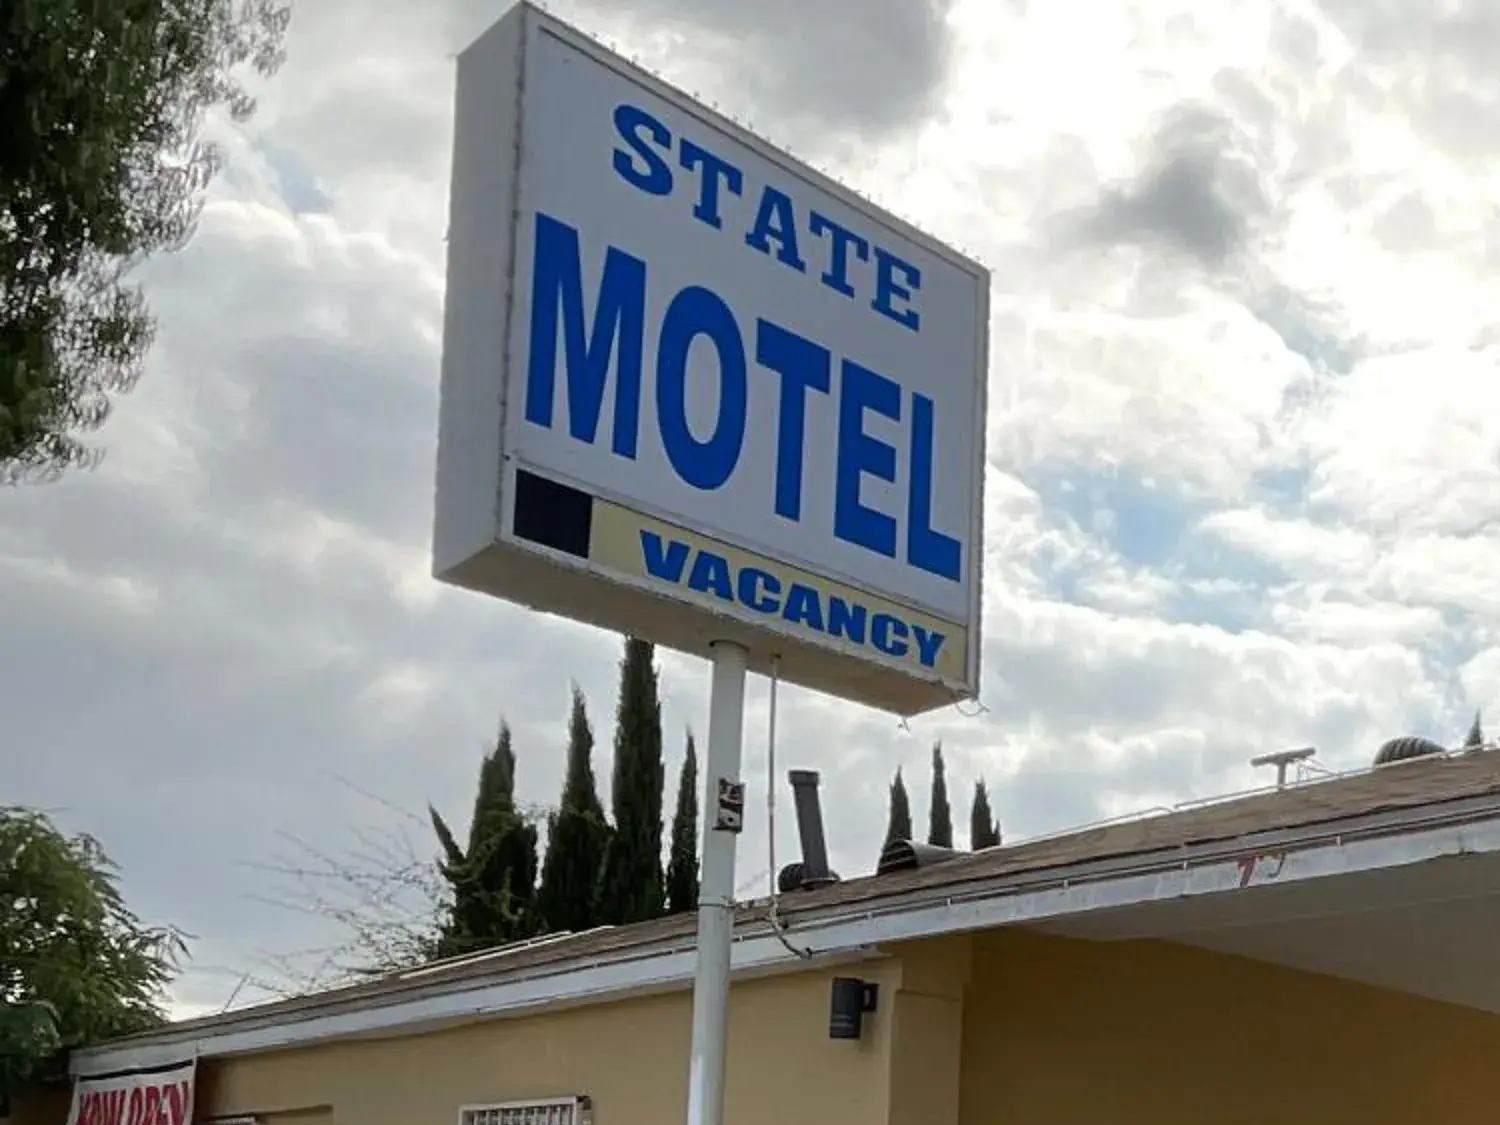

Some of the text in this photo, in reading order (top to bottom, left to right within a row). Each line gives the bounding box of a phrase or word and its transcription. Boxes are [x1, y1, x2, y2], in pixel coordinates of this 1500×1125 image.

[612, 103, 921, 331] STATE
[524, 211, 961, 583] MOTEL
[639, 529, 946, 667] VACANCY
